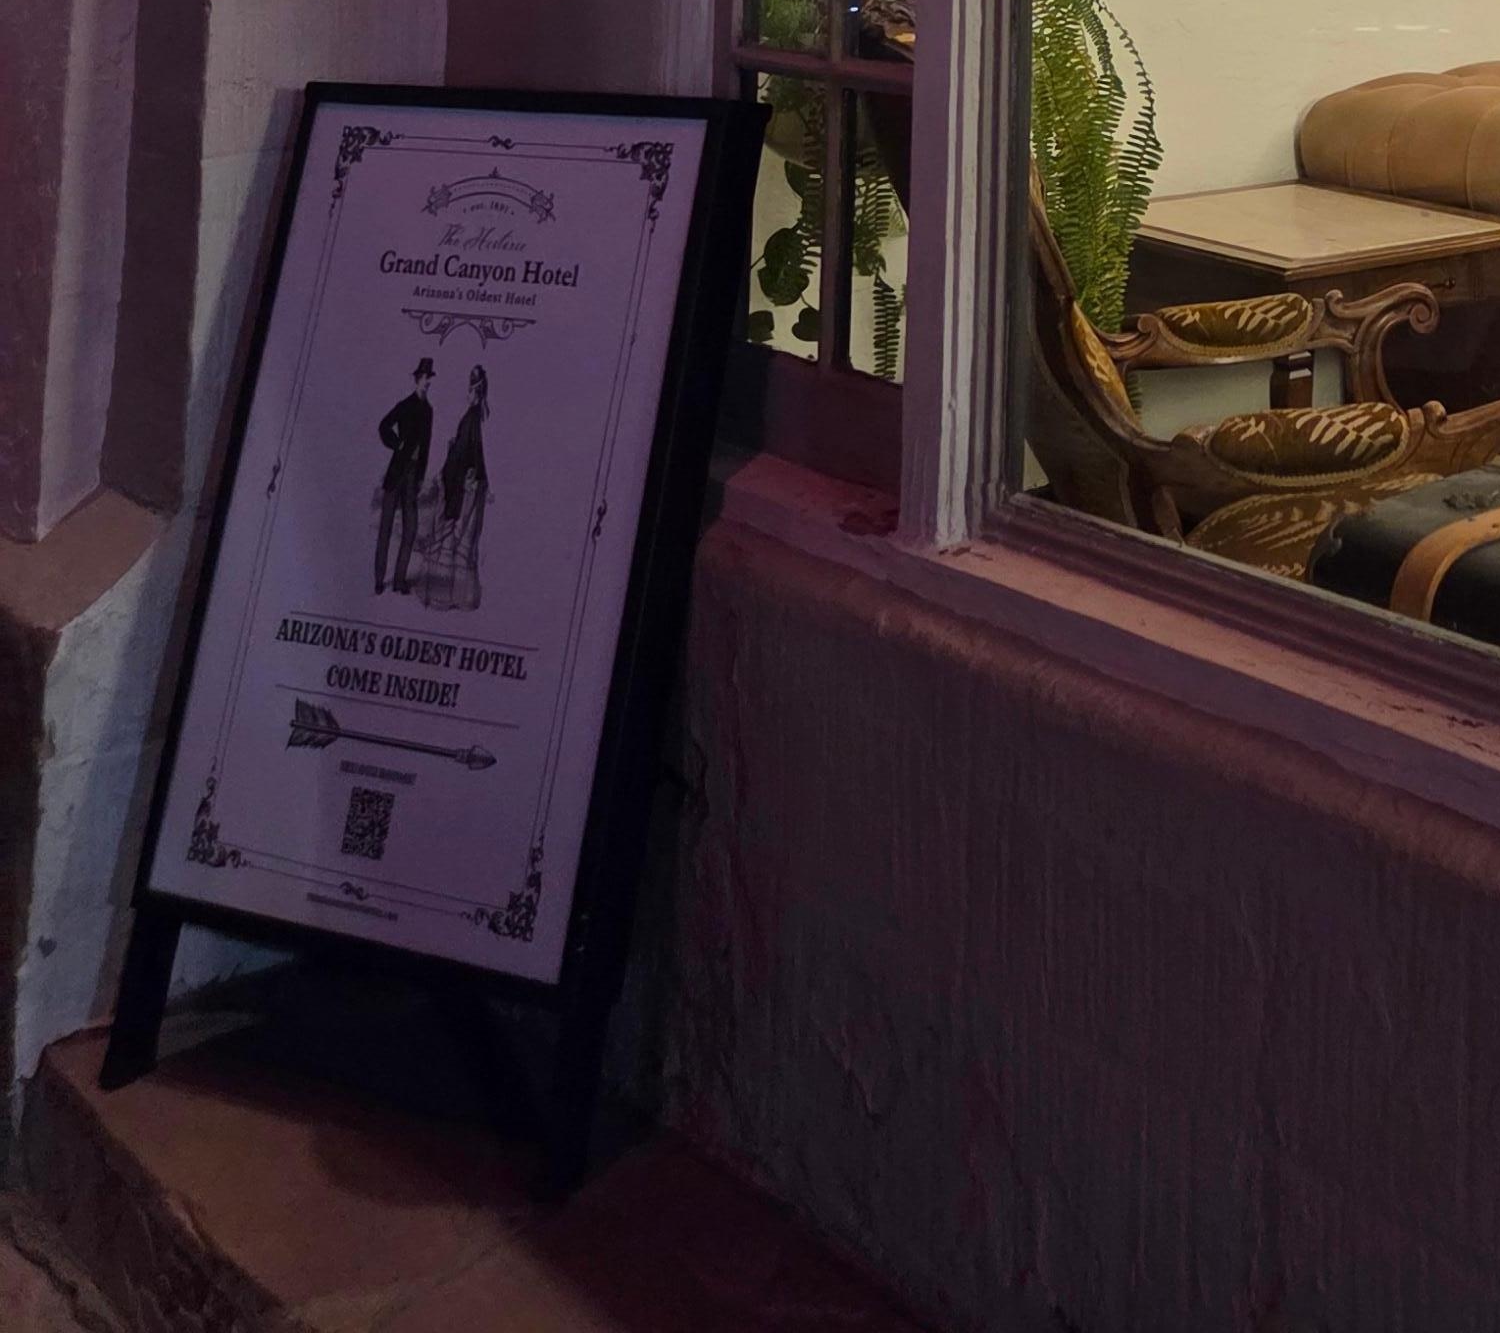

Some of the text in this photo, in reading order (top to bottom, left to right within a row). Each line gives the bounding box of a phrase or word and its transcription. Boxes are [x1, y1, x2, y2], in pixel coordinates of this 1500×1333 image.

[380, 250, 580, 287] Grand Canyon Hotel
[413, 285, 537, 306] Arizona's Oldest Hotel
[275, 618, 527, 681] ARIZONA'S OLDEST HOTEL
[326, 664, 461, 708] COME INSIDE!
